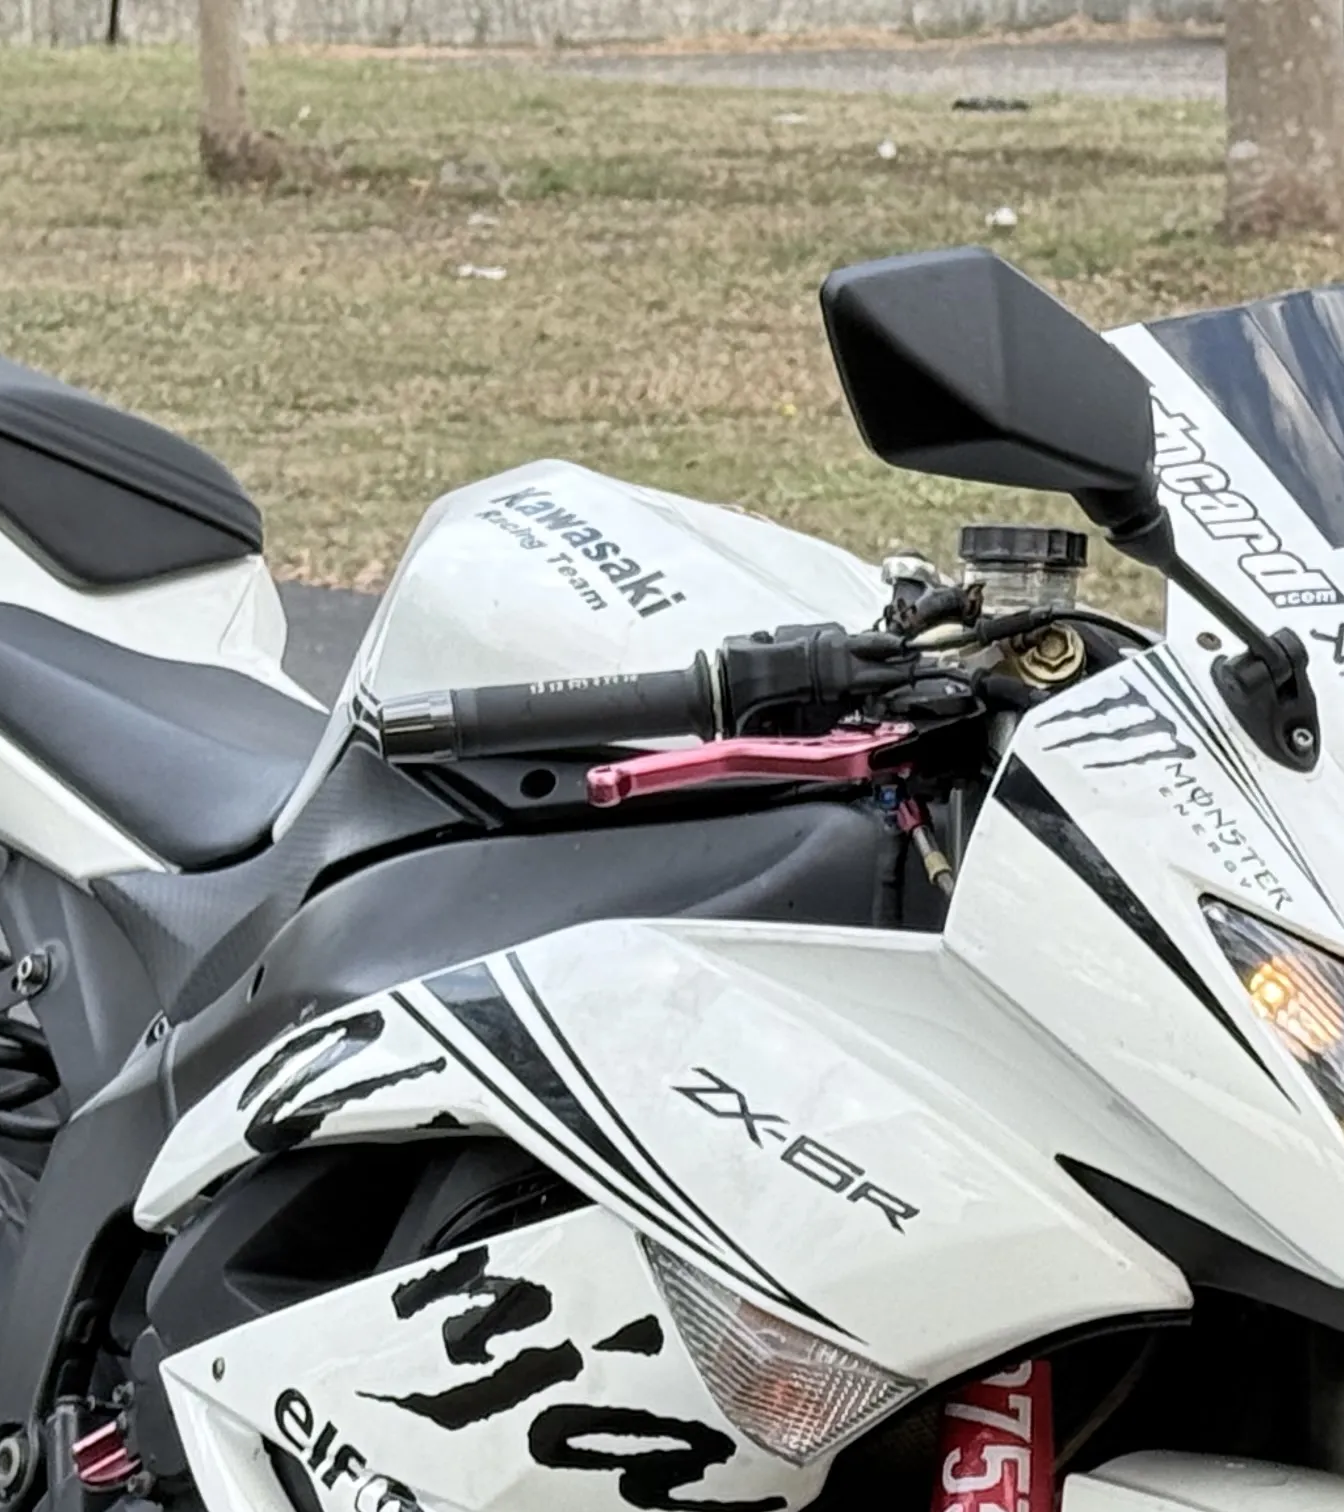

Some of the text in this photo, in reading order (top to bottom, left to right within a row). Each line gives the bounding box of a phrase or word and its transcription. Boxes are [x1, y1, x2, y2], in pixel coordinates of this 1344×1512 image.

[475, 509, 608, 612] Racing Team
[489, 487, 686, 618] Kawasaki
[669, 1066, 921, 1236] ZX-6R
